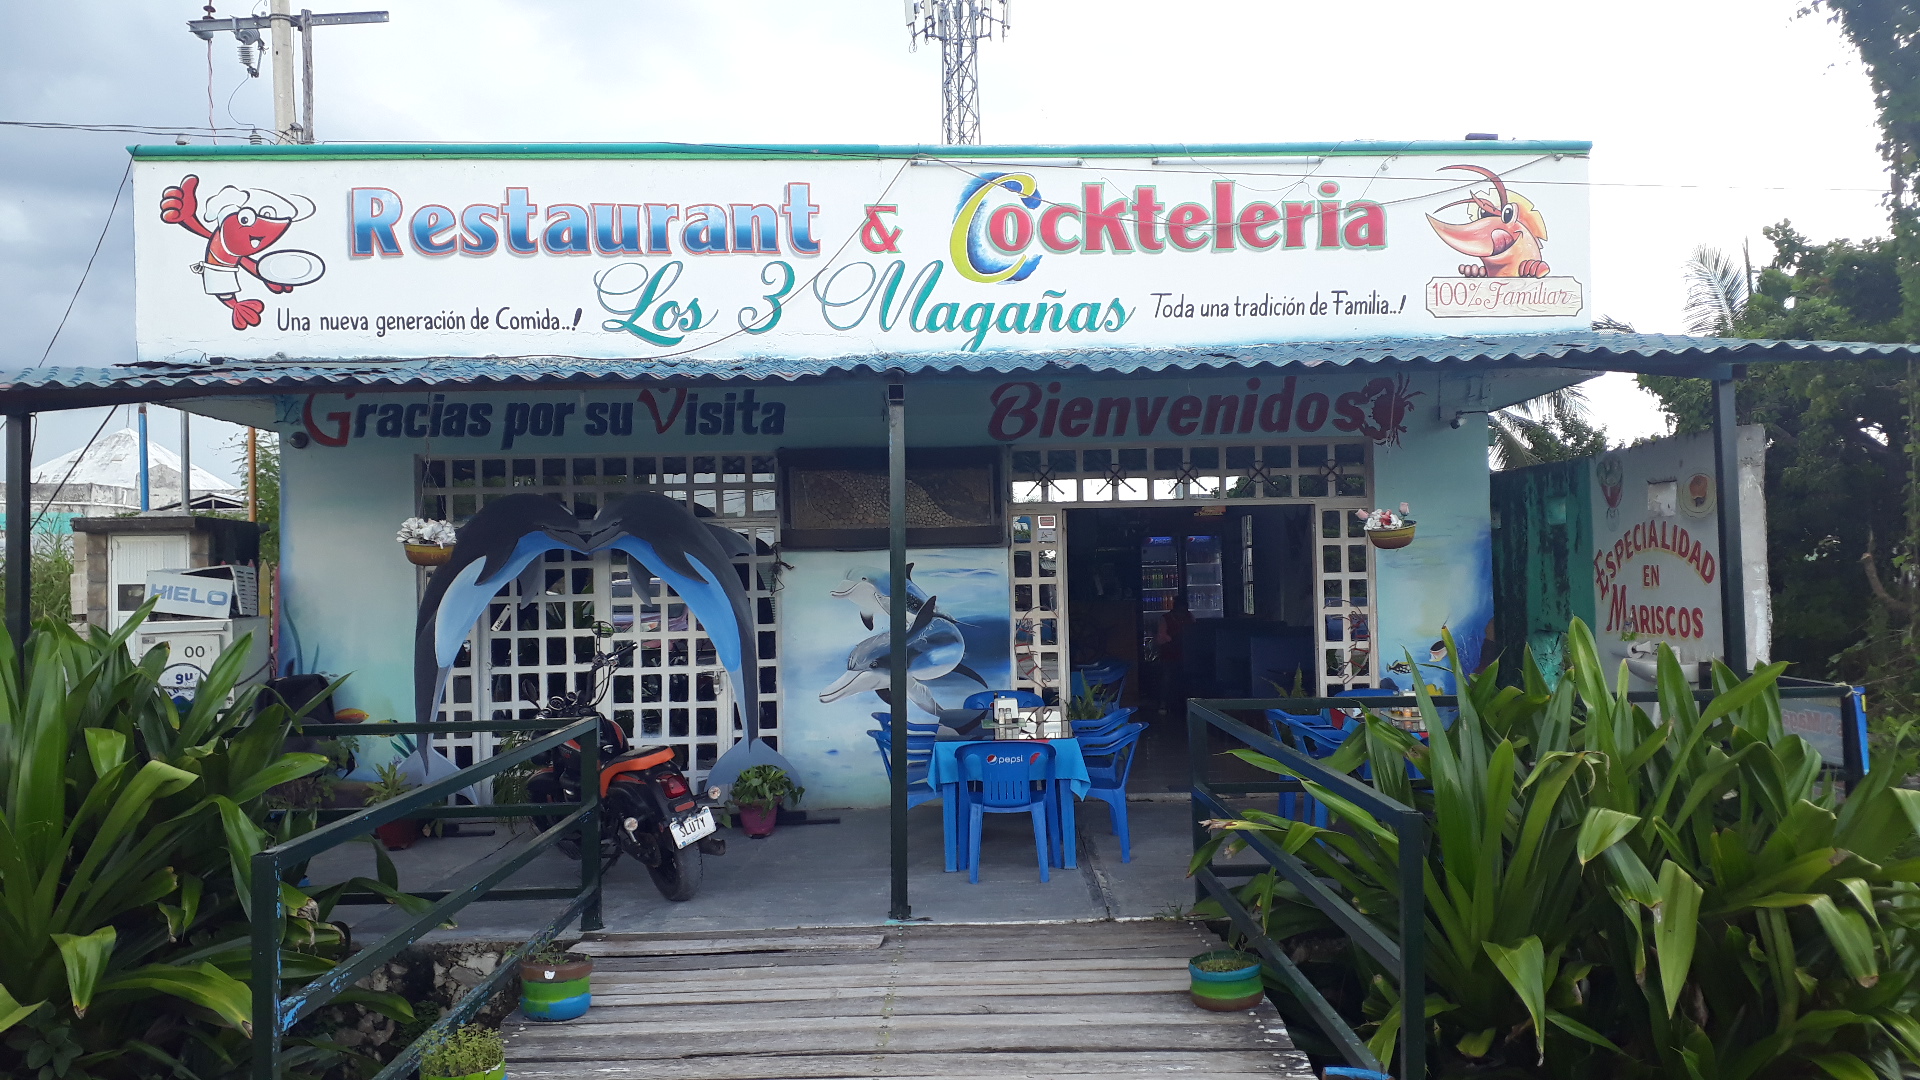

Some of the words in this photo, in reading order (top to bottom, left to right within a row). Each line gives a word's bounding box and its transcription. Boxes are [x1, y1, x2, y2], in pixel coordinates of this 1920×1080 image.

[348, 182, 821, 257] Restaurant
[860, 203, 902, 257] &
[950, 171, 1389, 284] Cockteleria
[594, 260, 719, 347] Los
[738, 260, 795, 335] 3
[812, 259, 1135, 352] Magañas
[1150, 293, 1195, 318] Toda
[1200, 302, 1229, 317] una
[1233, 293, 1304, 317] tradición
[1309, 291, 1328, 316] de
[1331, 289, 1407, 316] Familia..!
[1432, 281, 1483, 307] 100%
[1483, 281, 1572, 309] Familiar
[277, 307, 311, 331] Una
[319, 315, 369, 331] nueva
[376, 310, 466, 337] generación
[470, 307, 489, 330] de
[495, 306, 583, 331] Comida..!
[302, 392, 493, 447] Gracias
[500, 401, 575, 450] por
[584, 401, 635, 437] su
[636, 387, 786, 437] Visita
[987, 375, 1367, 441] Bienvenidos
[1593, 519, 1716, 600] ESPECIALIDAD
[1643, 564, 1660, 587] EN
[150, 583, 228, 606] HIELO
[1606, 583, 1705, 639] MARISCOS
[998, 754, 1024, 765] pepsi
